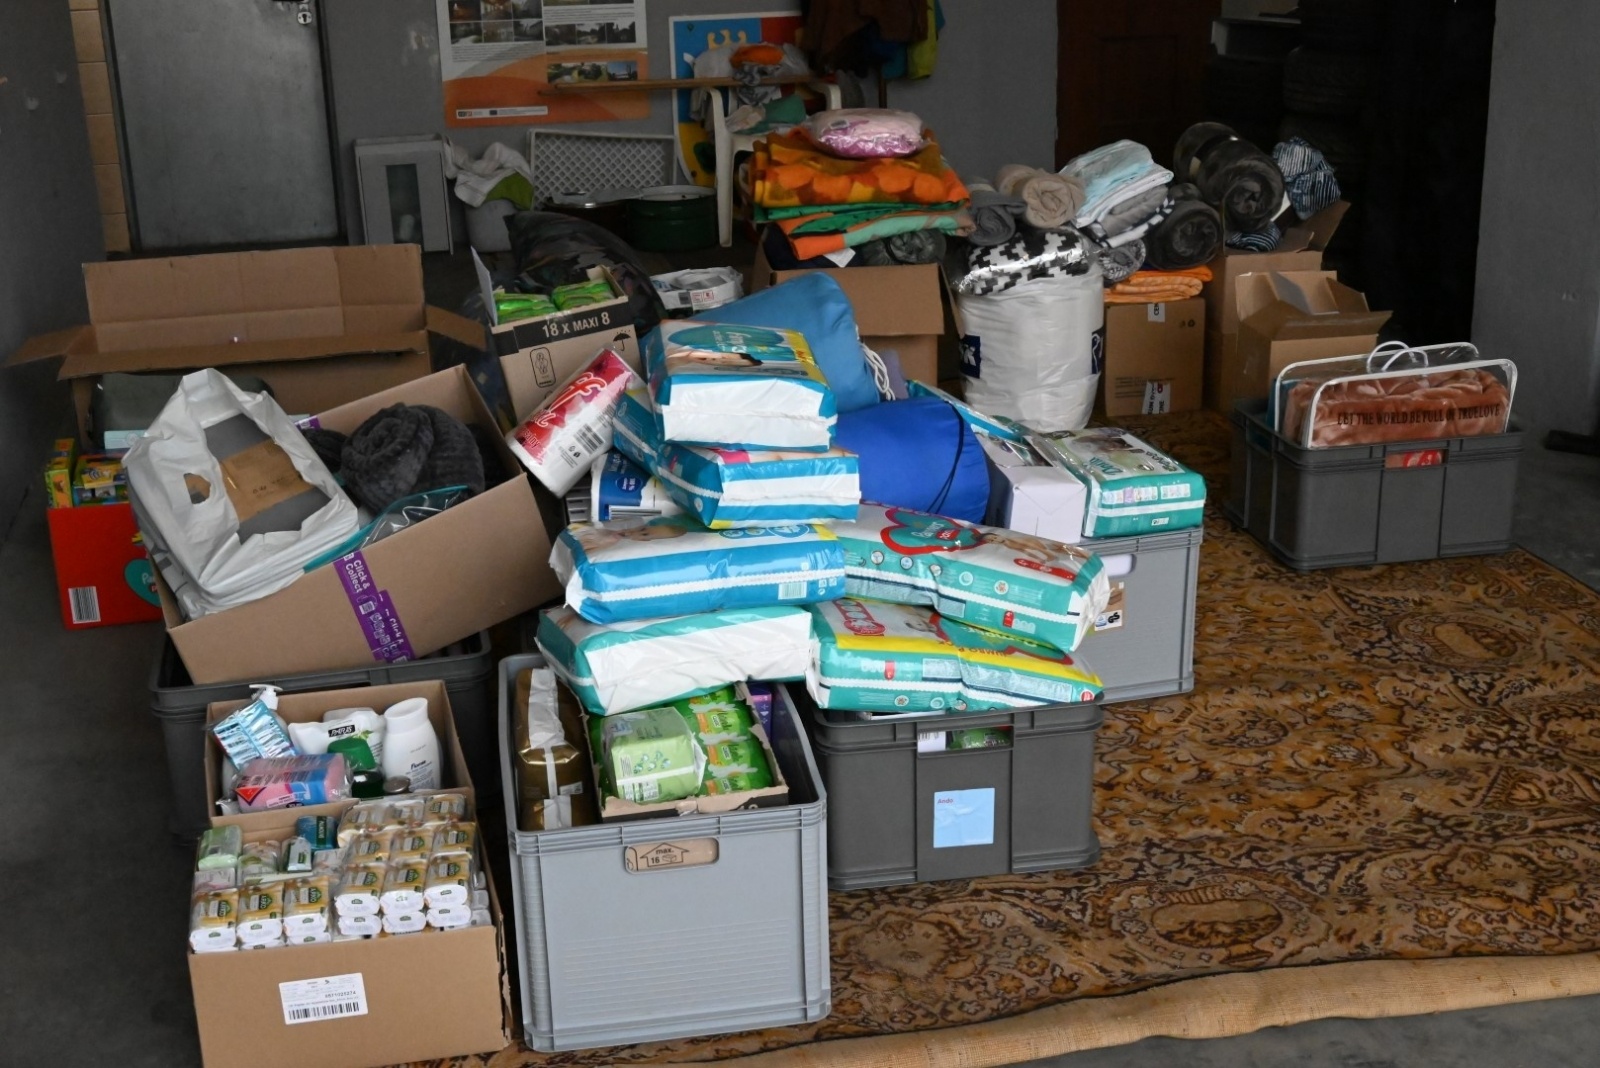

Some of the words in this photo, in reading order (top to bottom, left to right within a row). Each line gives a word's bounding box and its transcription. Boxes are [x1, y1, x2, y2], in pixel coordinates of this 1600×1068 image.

[542, 322, 559, 338] 18
[573, 316, 598, 331] MAXI
[601, 311, 611, 326] 8
[1356, 412, 1374, 425] THE
[1376, 410, 1408, 424] WORLD
[1409, 410, 1421, 423] BE
[1422, 409, 1443, 423] FULL
[1458, 403, 1501, 420] TRUELOVE
[345, 563, 363, 594] Collect
[353, 558, 369, 584] Click
[362, 580, 371, 591] &
[651, 856, 660, 864] 16
